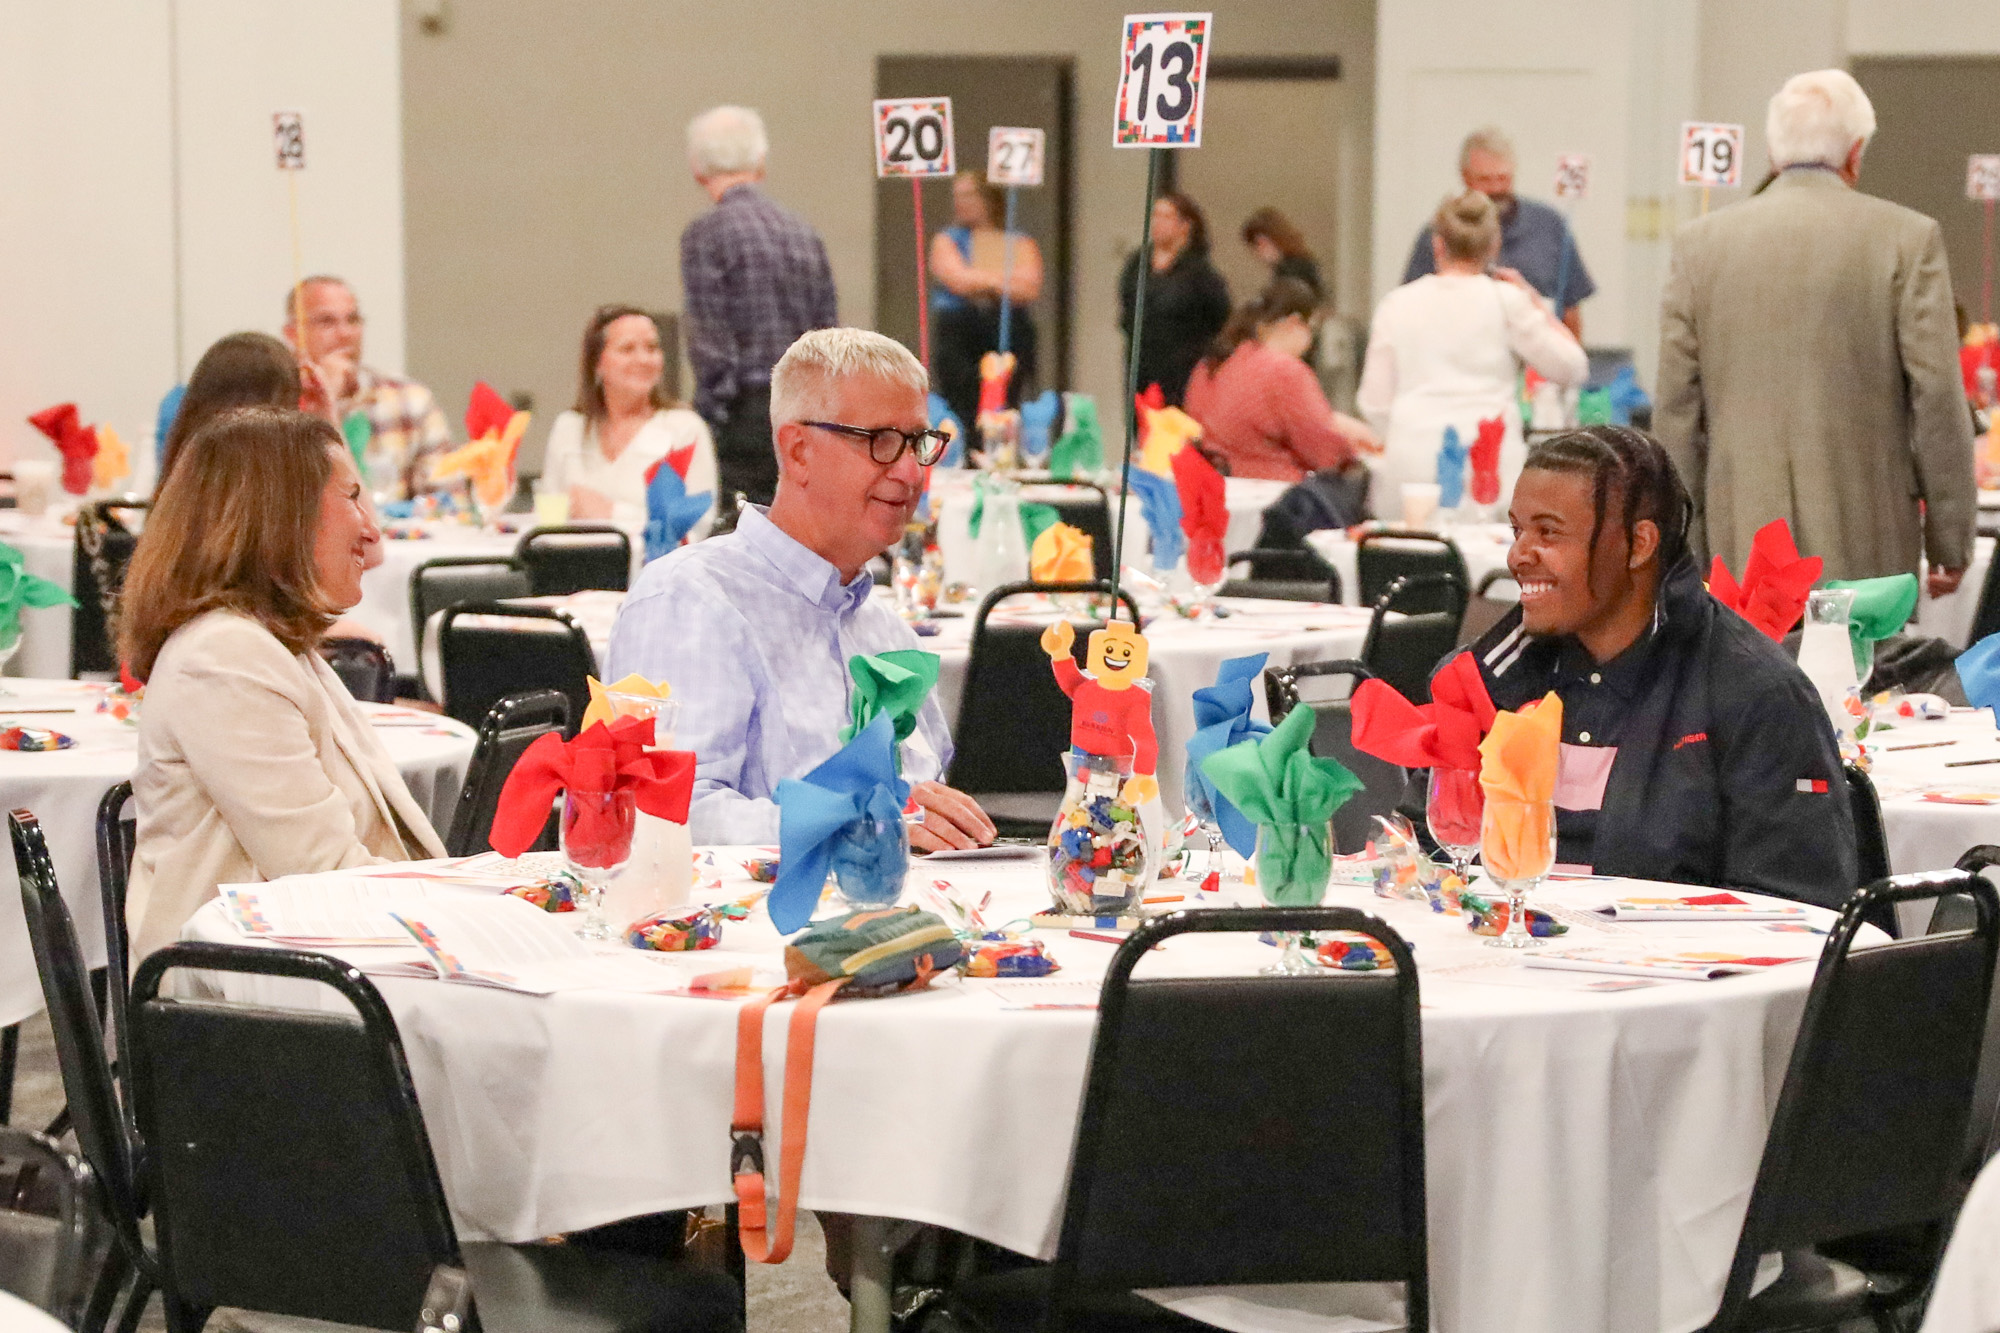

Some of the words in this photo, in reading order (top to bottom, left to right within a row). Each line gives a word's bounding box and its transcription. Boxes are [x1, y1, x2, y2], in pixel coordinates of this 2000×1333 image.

[1132, 41, 1194, 121] 13
[886, 116, 943, 162] 20
[998, 141, 1034, 170] 27
[1692, 138, 1734, 174] 19
